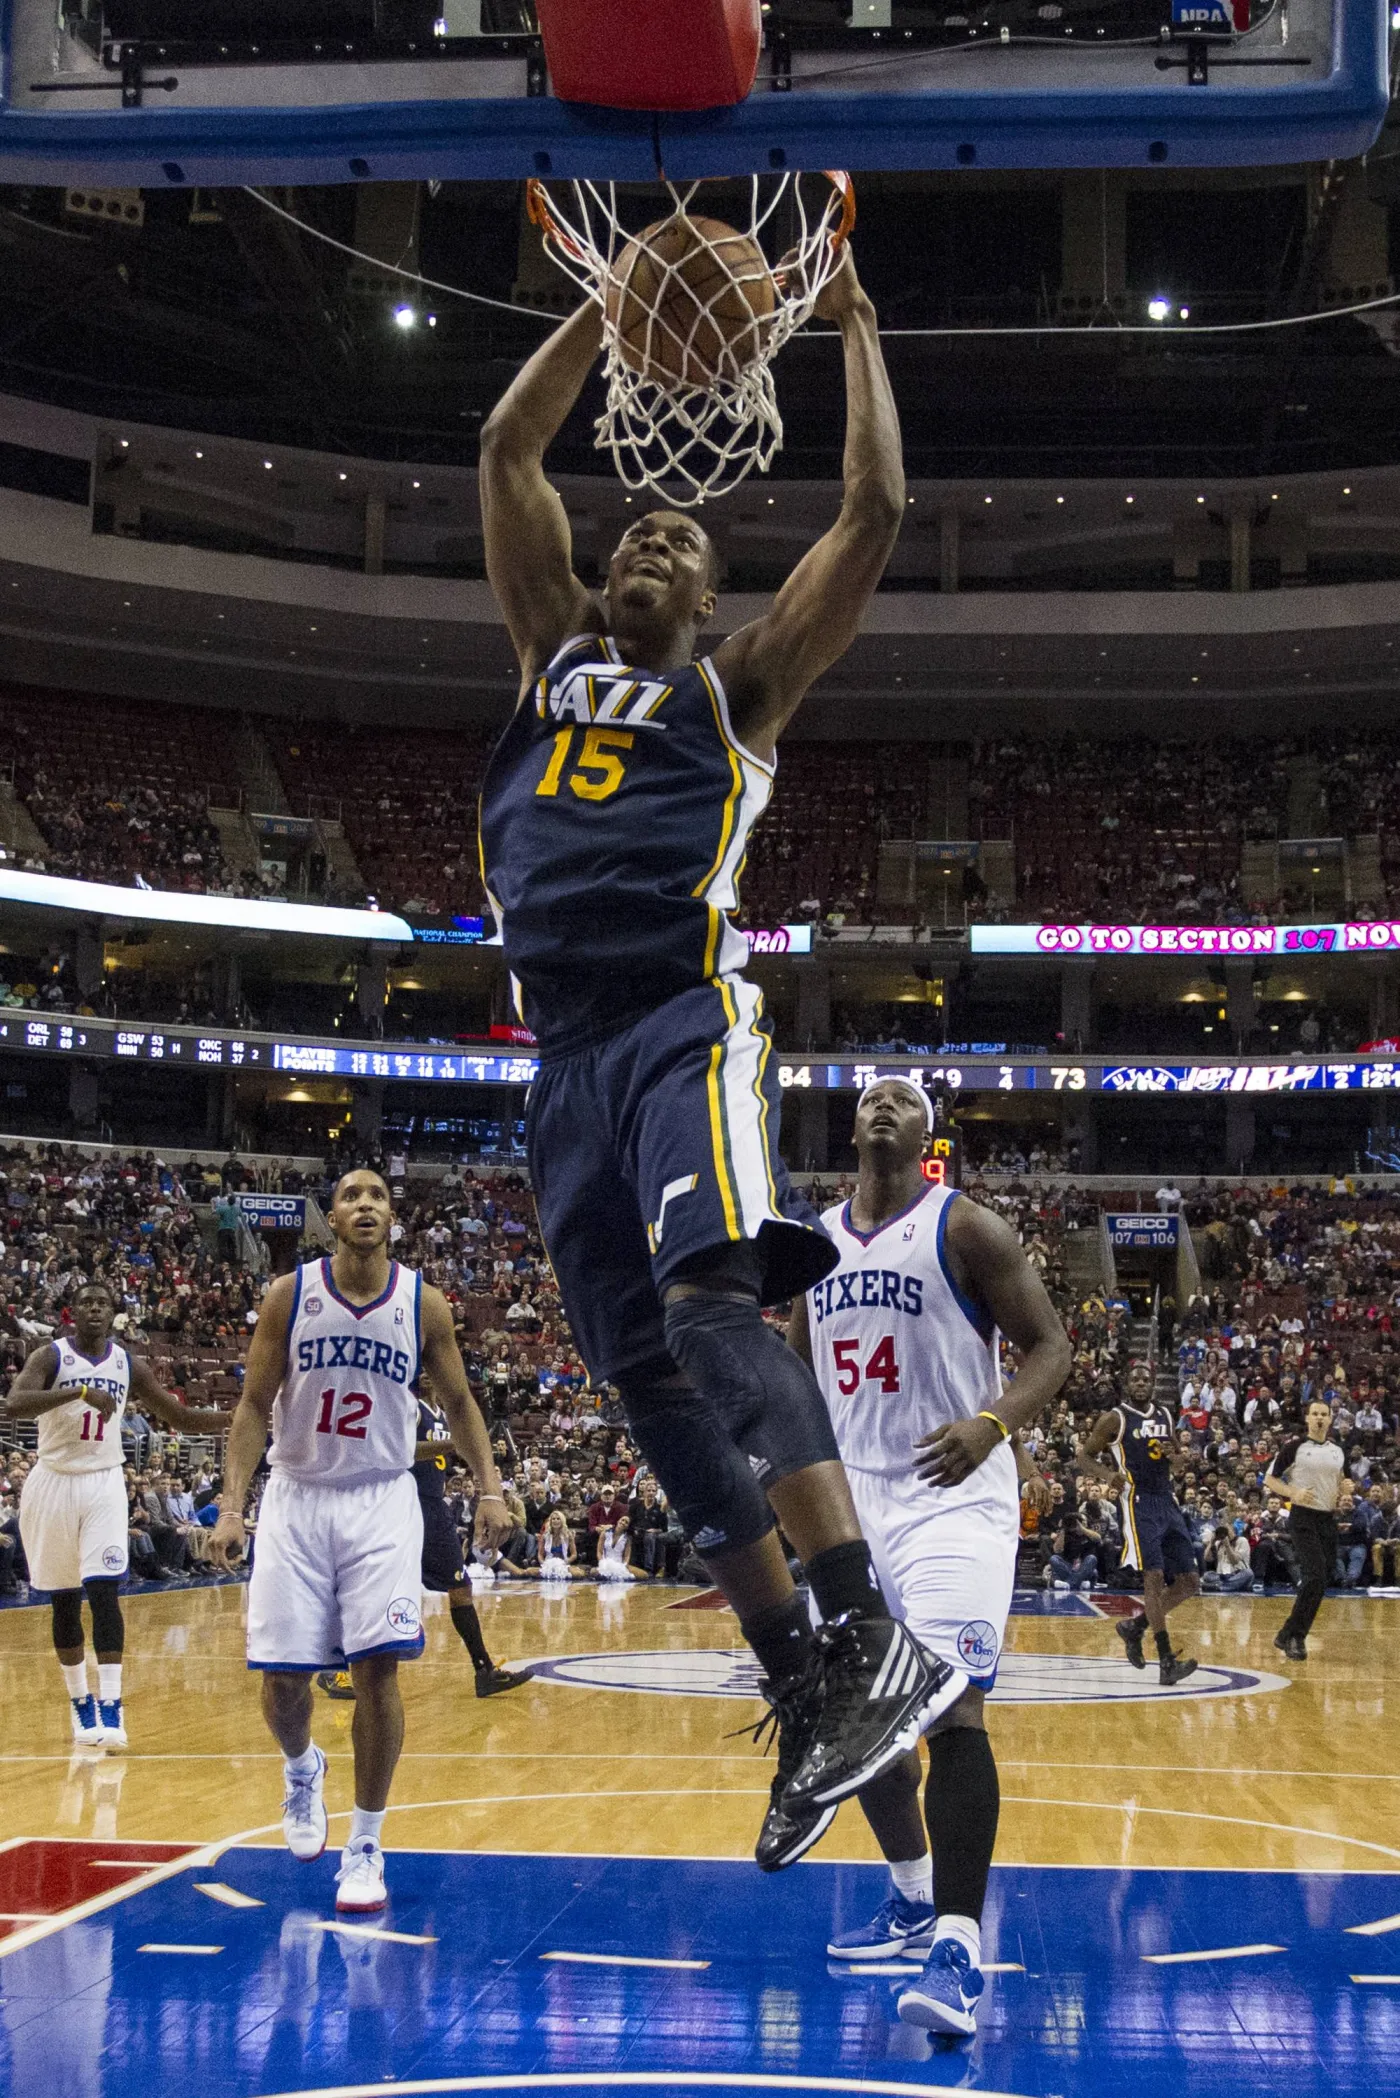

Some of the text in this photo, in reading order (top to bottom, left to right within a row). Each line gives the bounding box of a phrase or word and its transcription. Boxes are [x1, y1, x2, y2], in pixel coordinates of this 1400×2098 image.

[536, 663, 673, 730] JAZZ
[536, 724, 634, 801] 15
[1038, 928, 1081, 948] GO
[1092, 928, 1132, 948] TO
[1141, 927, 1274, 950] SECTION
[1284, 928, 1336, 951] 107
[27, 1034, 49, 1047] DET
[28, 1022, 50, 1036] ORL
[79, 1034, 87, 1046] 3
[117, 1032, 145, 1045] GSW
[172, 1043, 181, 1054] H
[117, 1044, 138, 1056] MIN
[198, 1050, 244, 1065] NOH 37
[199, 1039, 222, 1051] OKC
[251, 1048, 259, 1060] 2
[281, 1044, 337, 1061] PLAYER
[281, 1057, 335, 1073] POINTS
[777, 1066, 812, 1088] 84
[998, 1073, 1014, 1090] 4
[1050, 1067, 1086, 1091] 73
[1334, 1072, 1349, 1089] 2
[1369, 1071, 1384, 1088] 2
[241, 1197, 297, 1212] GEICO
[278, 1213, 302, 1227] 108
[1115, 1218, 1169, 1229] GEICO
[1152, 1231, 1176, 1244] 106
[813, 1269, 923, 1324] SIXERS
[298, 1335, 409, 1385] SIXERS
[832, 1334, 900, 1396] 54
[316, 1387, 373, 1440] 12
[80, 1410, 104, 1442] 11
